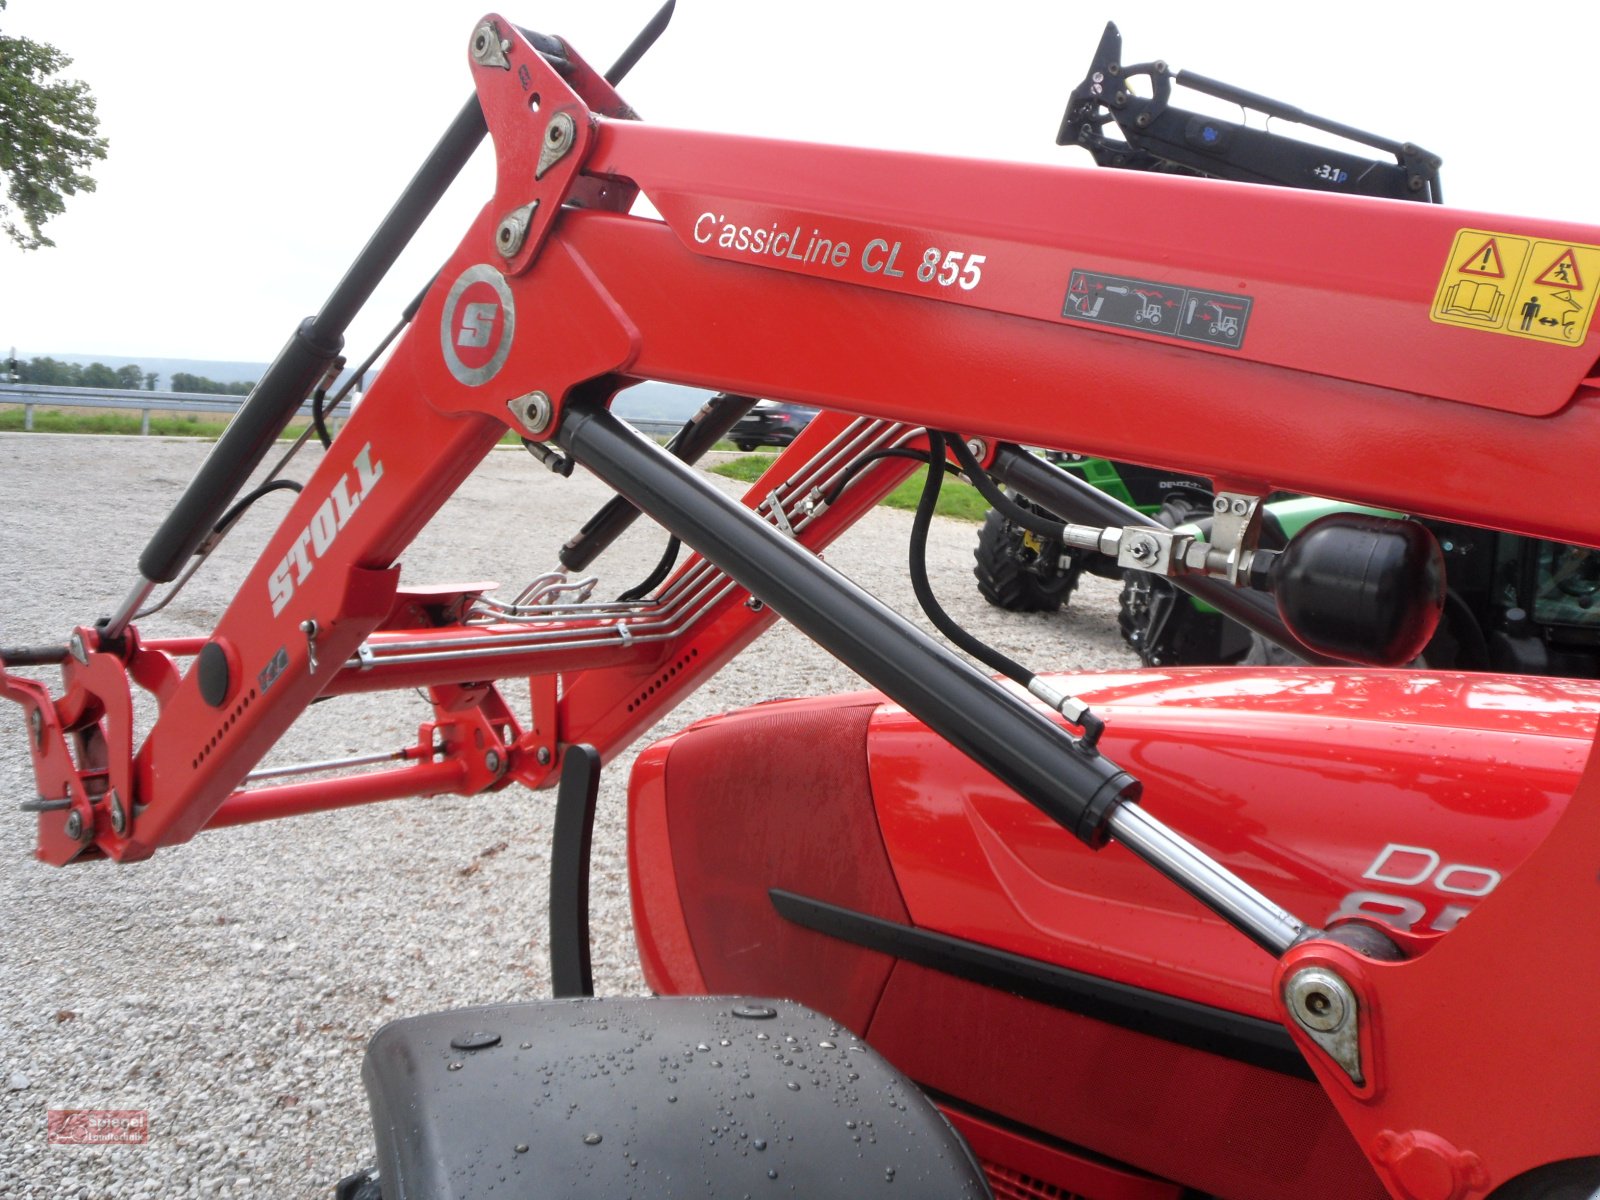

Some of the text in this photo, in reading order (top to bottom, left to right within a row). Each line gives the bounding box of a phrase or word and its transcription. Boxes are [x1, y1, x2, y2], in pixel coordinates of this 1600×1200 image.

[693, 212, 986, 290] CassicLine CL 855
[457, 302, 498, 348] S
[268, 441, 384, 619] STOLL
